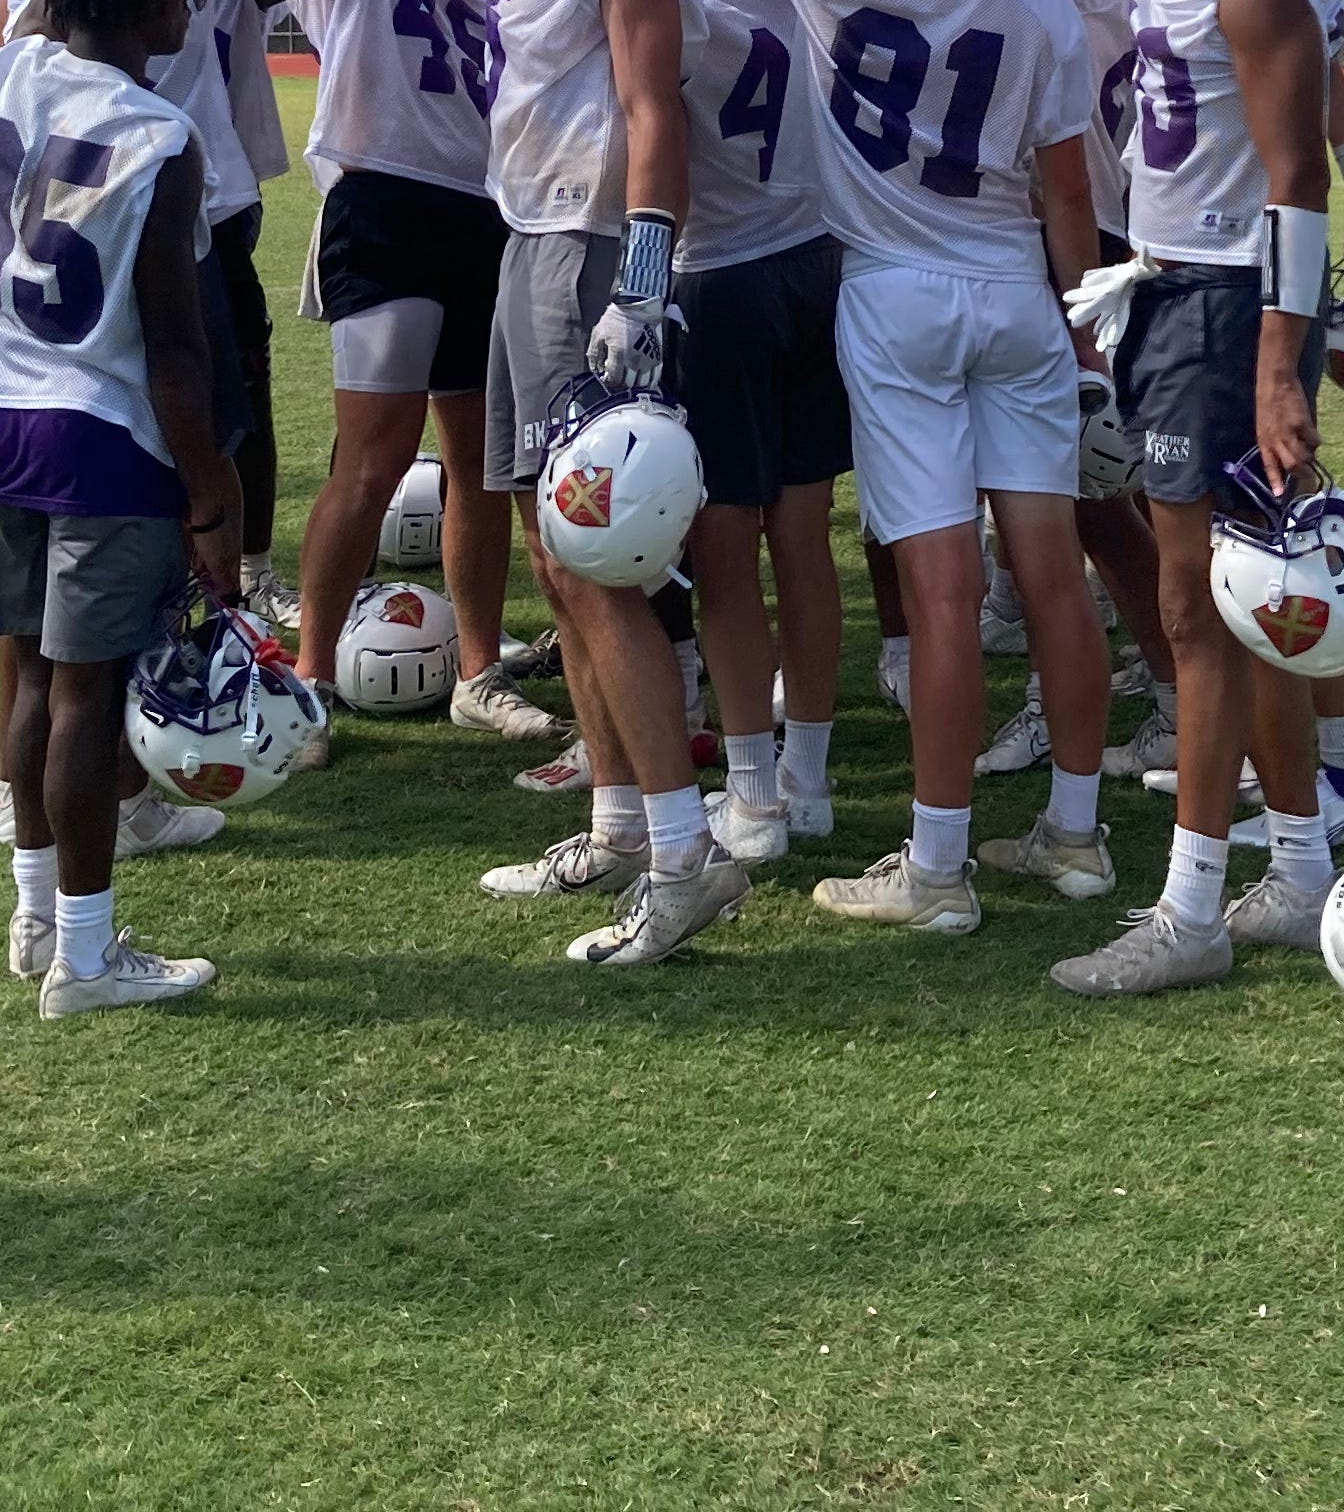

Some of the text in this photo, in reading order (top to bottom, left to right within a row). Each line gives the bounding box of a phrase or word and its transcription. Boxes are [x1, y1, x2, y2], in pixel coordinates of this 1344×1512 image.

[719, 28, 790, 183] 4
[831, 7, 1005, 197] 81
[1154, 442, 1189, 465] RYAN
